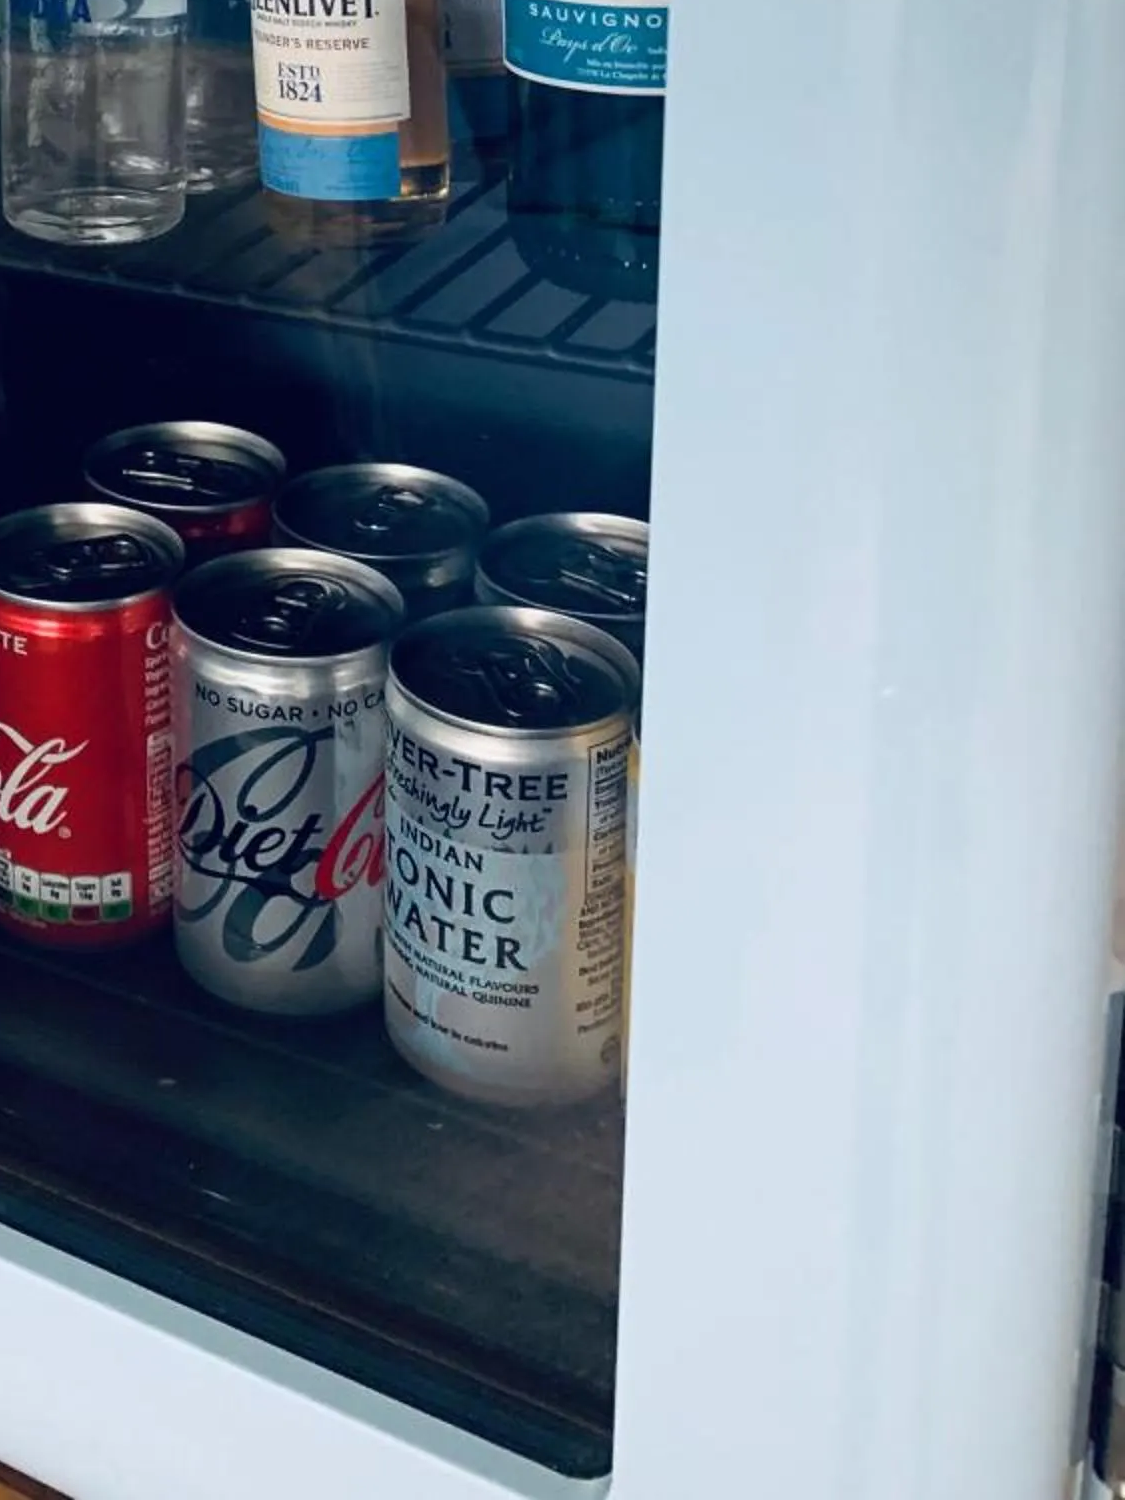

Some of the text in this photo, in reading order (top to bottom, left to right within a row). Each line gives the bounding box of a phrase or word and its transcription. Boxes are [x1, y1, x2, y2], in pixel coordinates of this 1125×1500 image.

[528, 2, 663, 29] SAUVIGNO
[306, 36, 371, 51] RESERVE
[277, 79, 323, 103] 1824
[195, 681, 358, 722] NO SUGAR NO
[387, 725, 568, 802] VER-TREE
[175, 762, 325, 895] Diet
[400, 815, 484, 874] INDIAN
[386, 826, 516, 924] TONIC
[387, 879, 529, 972] WATER
[414, 950, 466, 982] NATURAL
[469, 975, 540, 996] FLAVOURS
[414, 965, 468, 997] NATURAL
[471, 991, 532, 1009] QUININE
